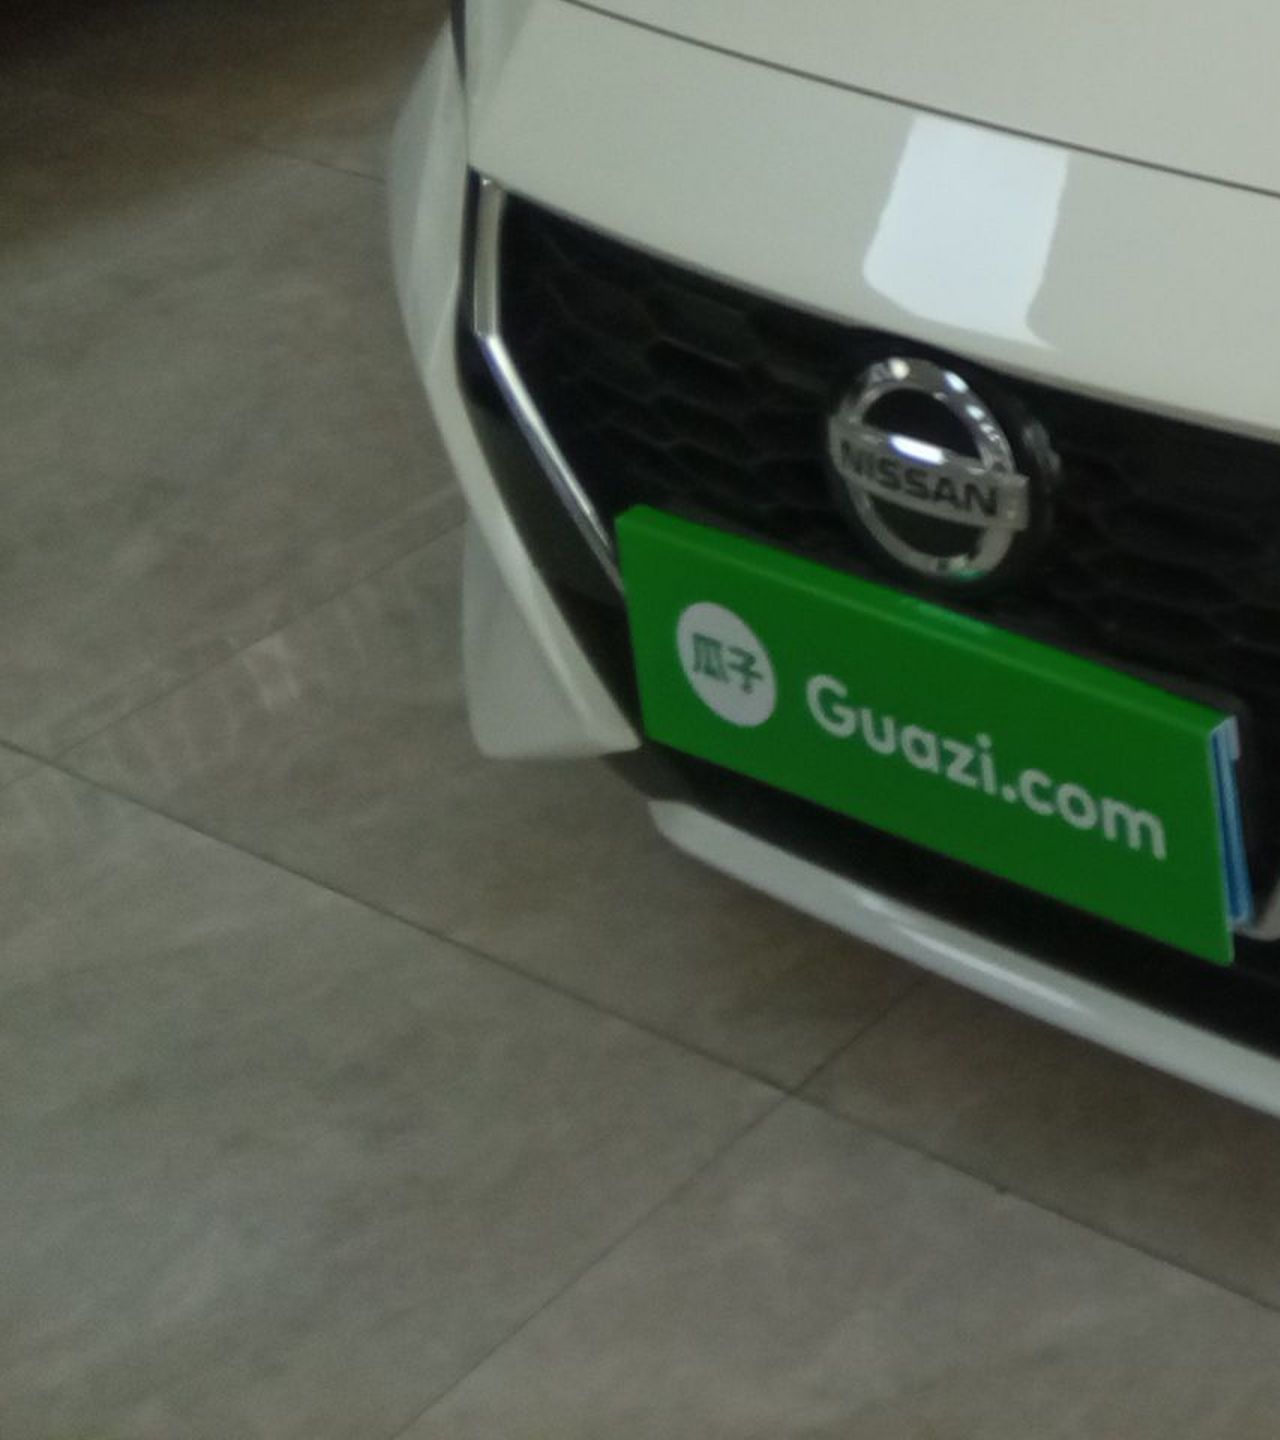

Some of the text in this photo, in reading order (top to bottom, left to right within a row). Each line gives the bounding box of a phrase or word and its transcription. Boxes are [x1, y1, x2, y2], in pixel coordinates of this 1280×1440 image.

[840, 442, 999, 517] NISSAN
[691, 633, 763, 695] 瓜子
[805, 673, 1166, 860] Guazi.com
